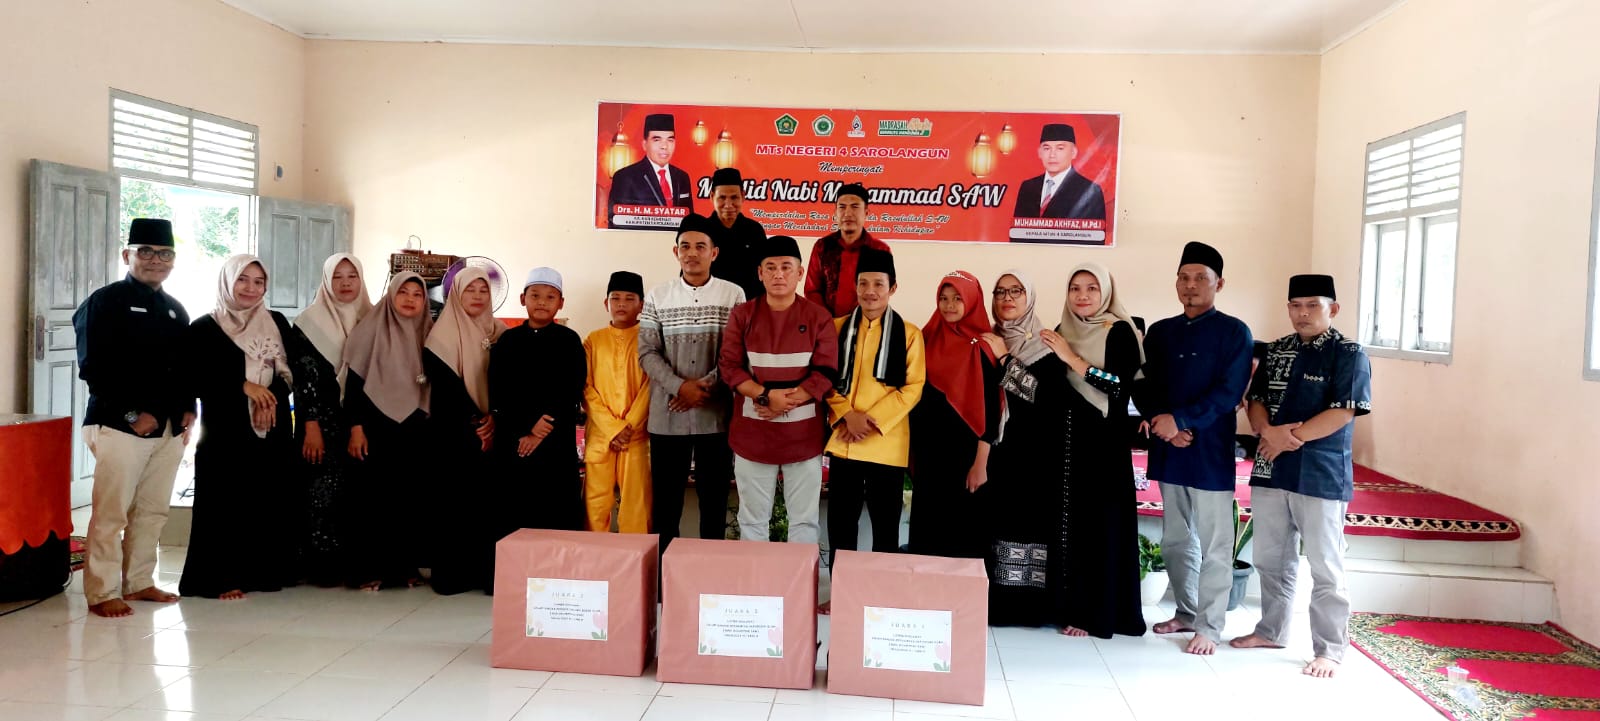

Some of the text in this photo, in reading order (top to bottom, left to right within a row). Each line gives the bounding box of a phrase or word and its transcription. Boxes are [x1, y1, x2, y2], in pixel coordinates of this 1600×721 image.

[756, 144, 950, 159] MTs NEGERI 4 SAROLANGUN
[819, 161, 883, 176] Memperingati
[698, 178, 1006, 208] Mlid Nabi Mammad SAW
[617, 206, 634, 214] Drs.
[654, 208, 686, 216] SYATAR
[1014, 219, 1053, 228] MUHAMMAD
[1054, 220, 1080, 229] AKHFAZ,
